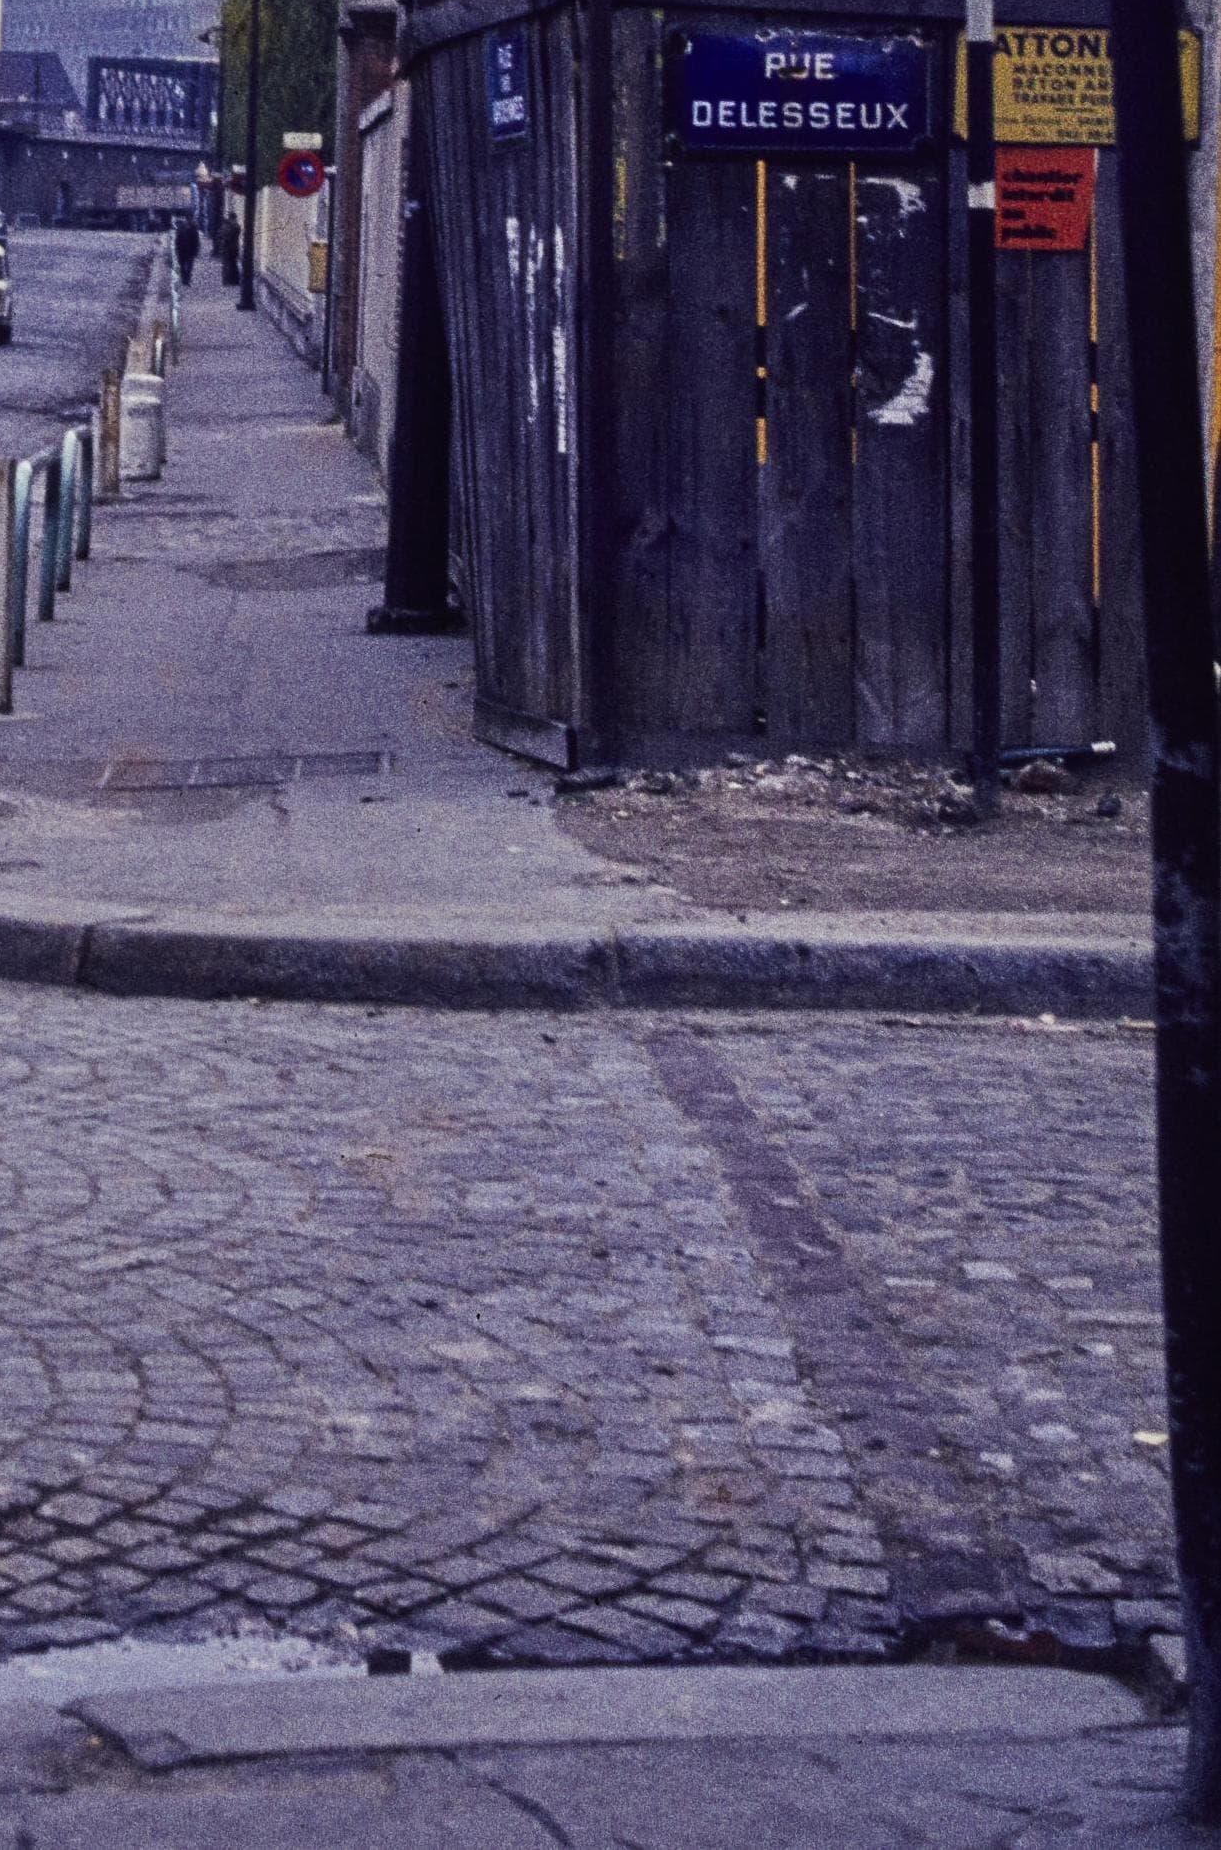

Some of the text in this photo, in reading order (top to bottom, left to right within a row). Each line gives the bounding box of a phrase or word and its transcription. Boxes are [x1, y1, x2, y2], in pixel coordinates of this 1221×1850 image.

[994, 32, 1111, 58] ATTON
[764, 52, 837, 80] RUE
[691, 100, 909, 130] DELESSEUX
